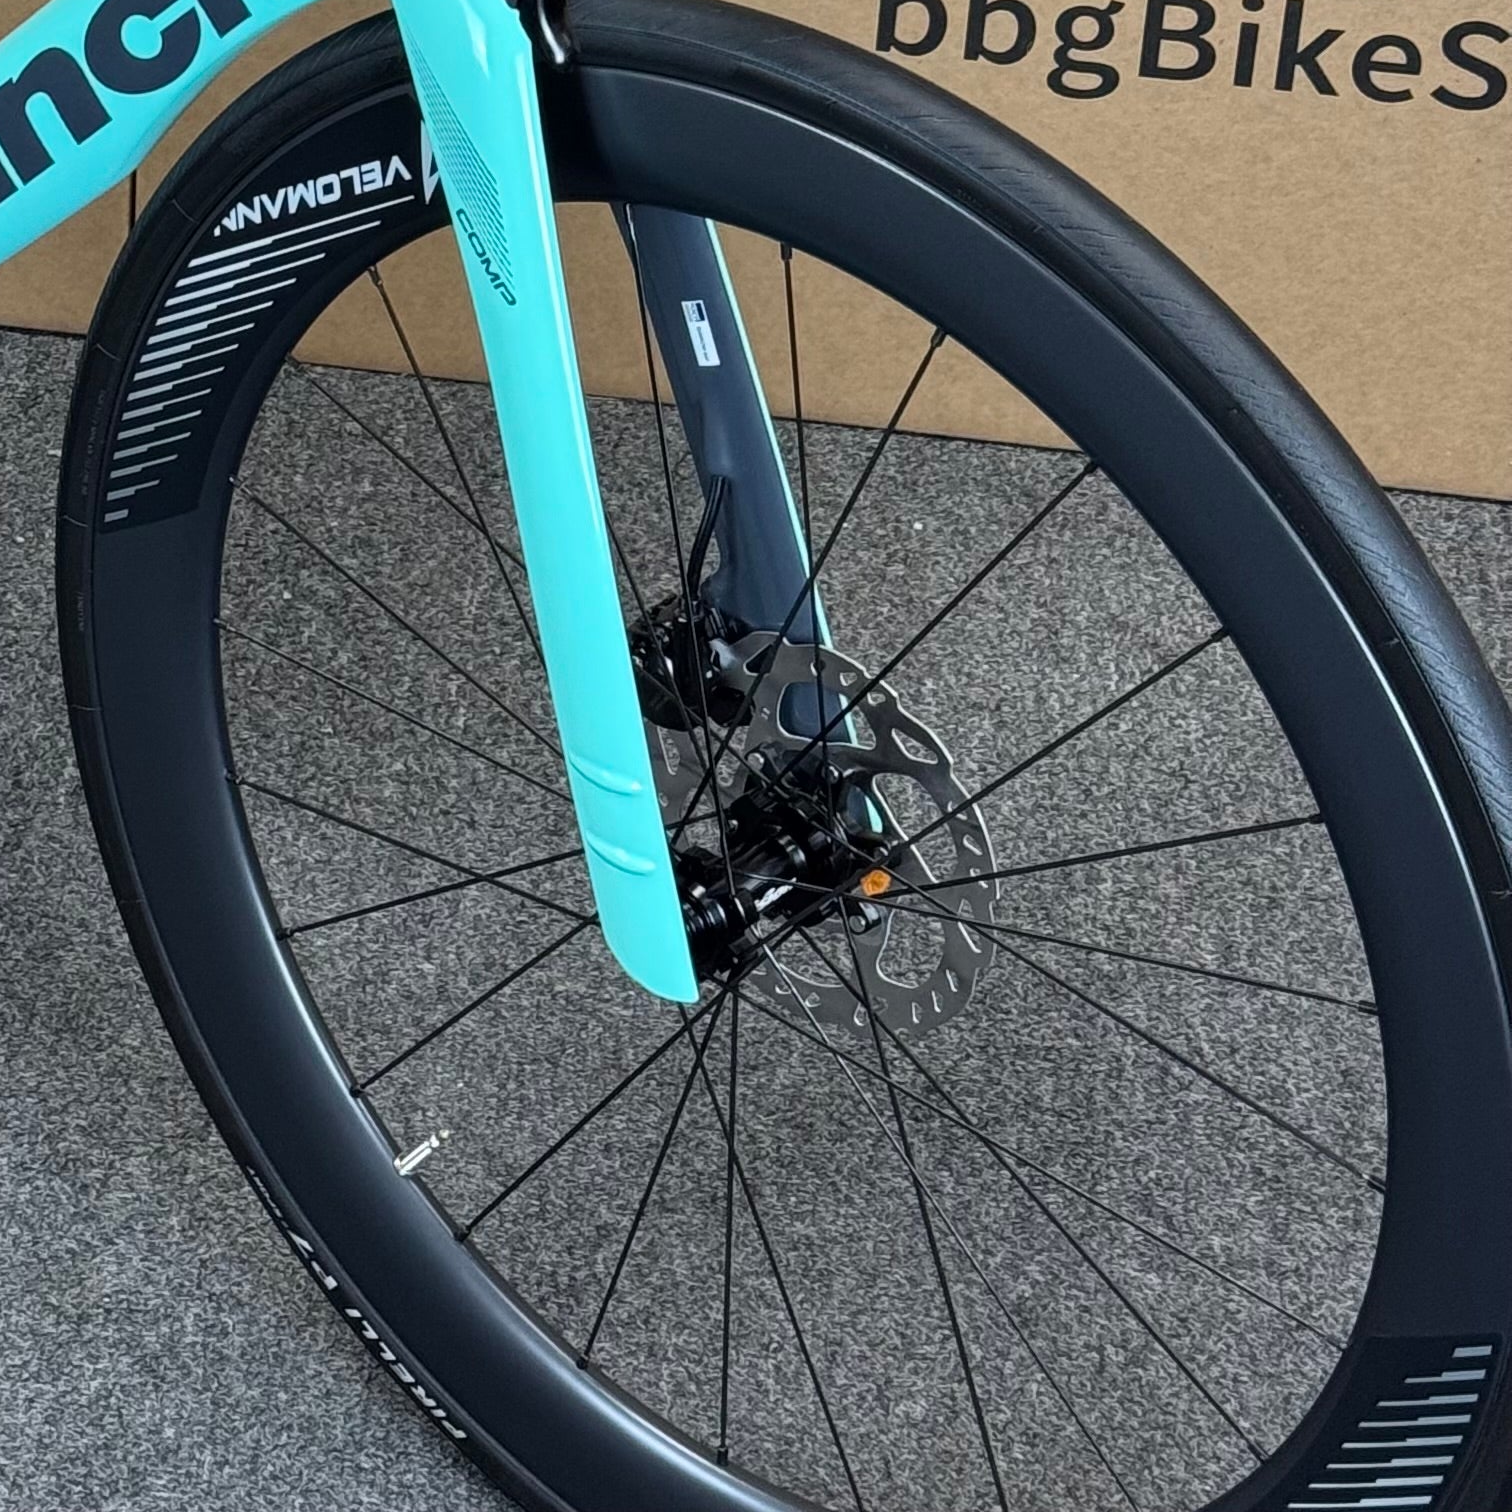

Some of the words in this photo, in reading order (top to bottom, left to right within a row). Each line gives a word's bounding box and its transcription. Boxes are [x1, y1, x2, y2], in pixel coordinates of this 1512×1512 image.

[213, 154, 413, 236] VELOMANN
[455, 208, 517, 306] COMP
[345, 1308, 467, 1440] PIRELLI
